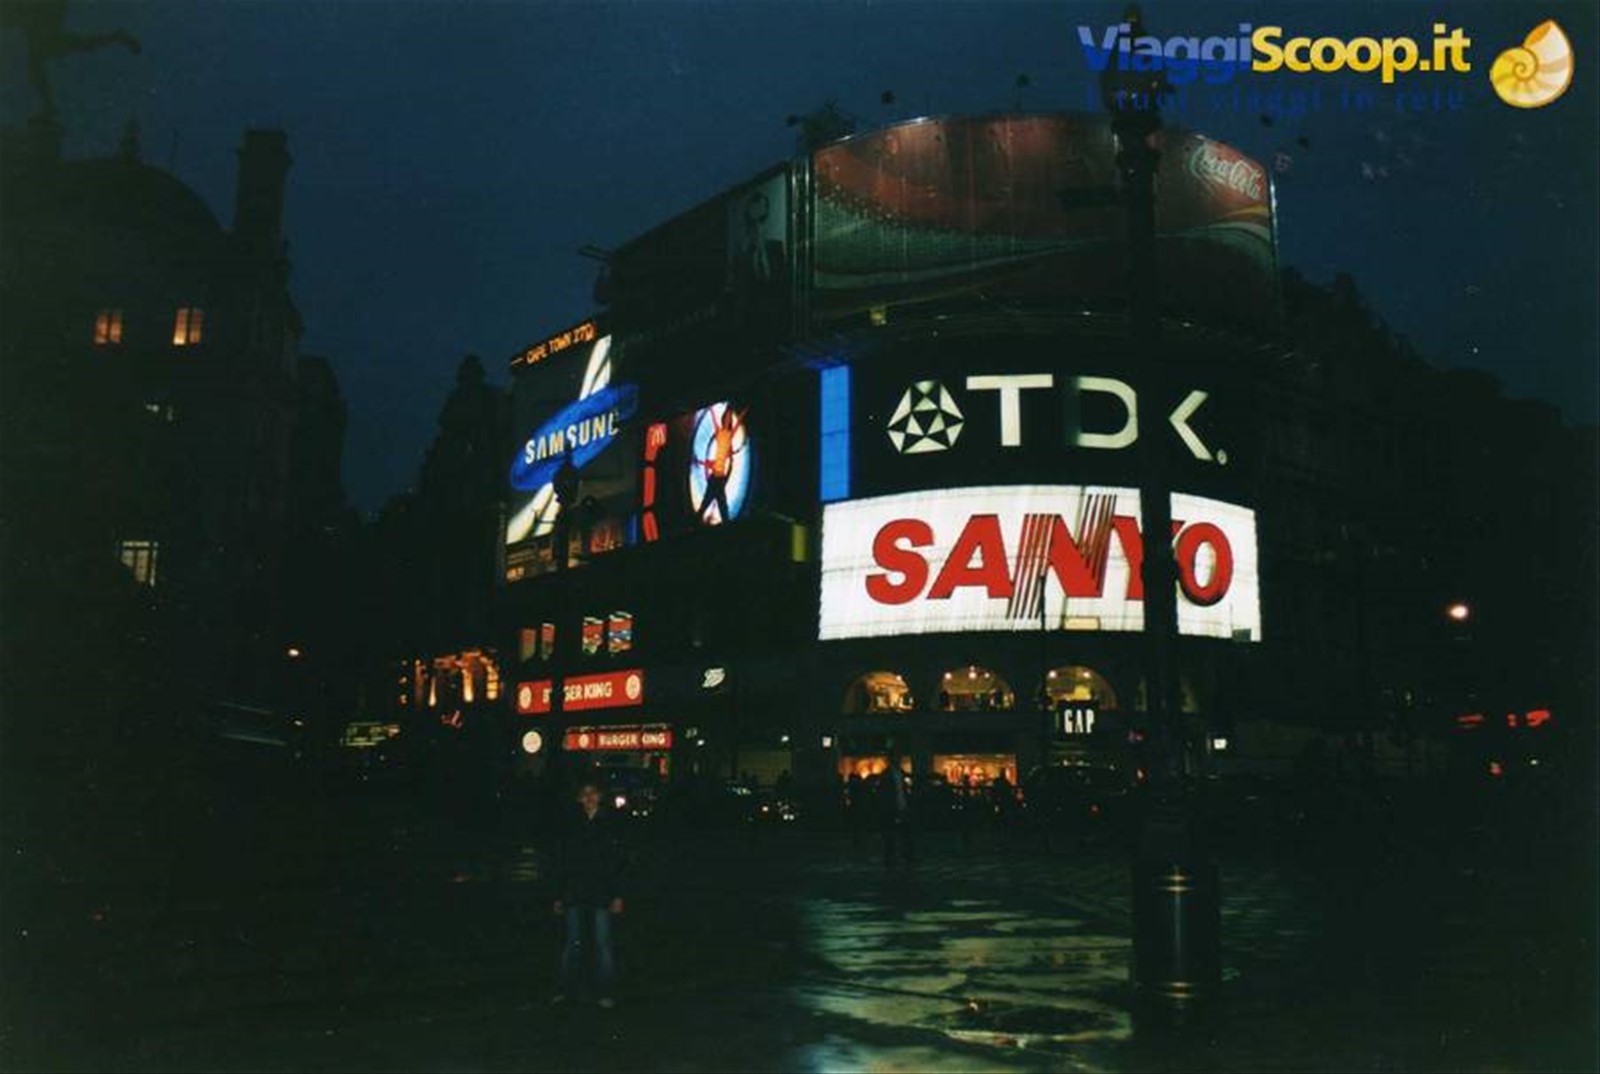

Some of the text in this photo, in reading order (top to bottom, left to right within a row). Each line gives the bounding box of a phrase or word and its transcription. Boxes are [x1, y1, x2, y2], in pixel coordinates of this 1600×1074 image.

[966, 373, 1212, 462] TDK
[865, 494, 1234, 620] SANYO
[584, 681, 613, 700] KING
[1063, 708, 1095, 734] GAP
[598, 733, 638, 748] BURGER
